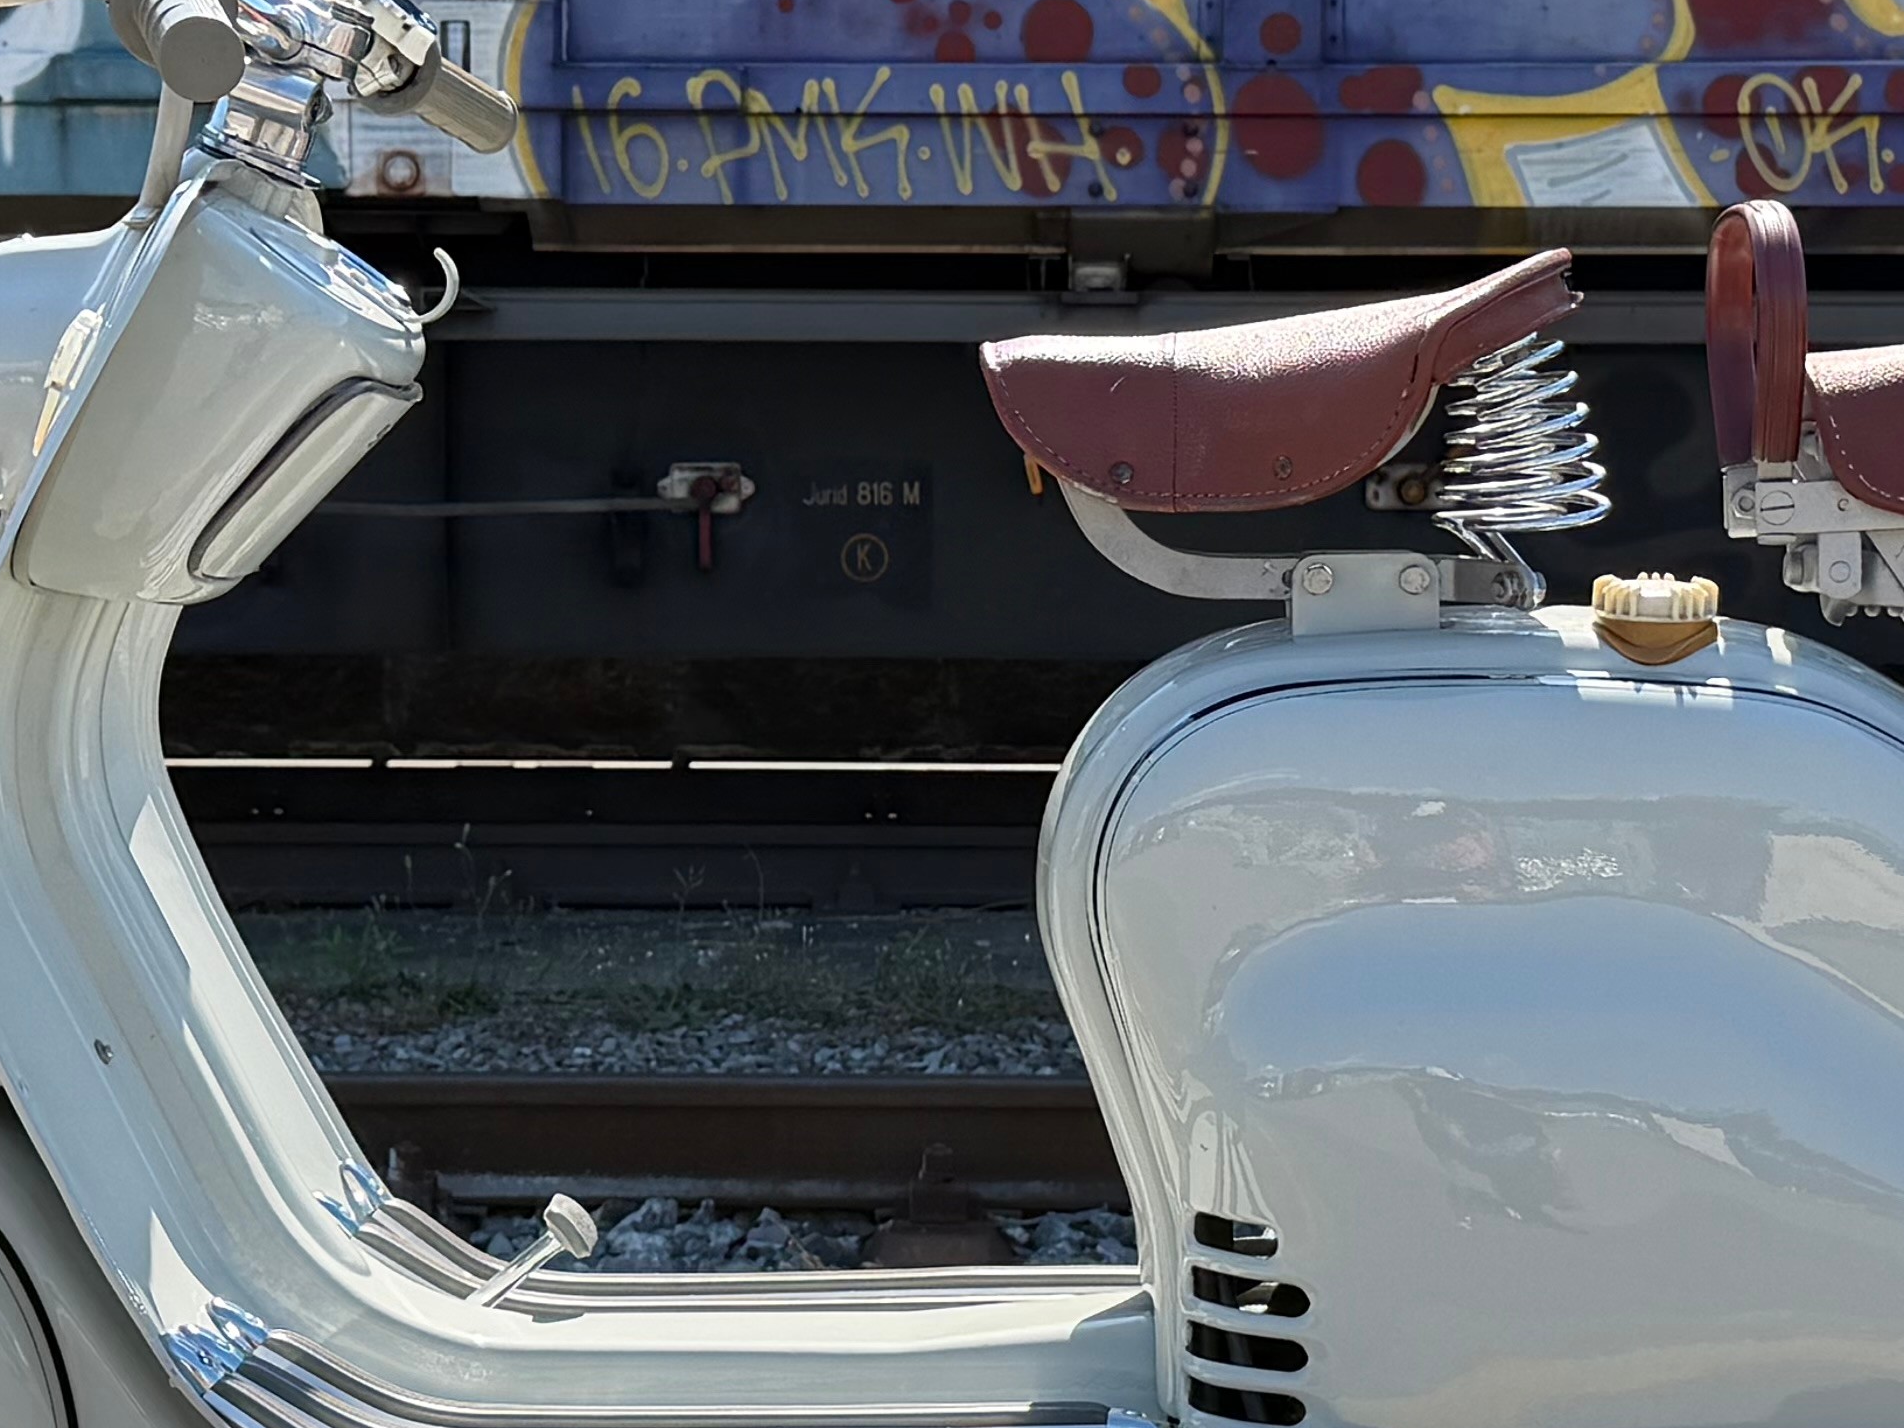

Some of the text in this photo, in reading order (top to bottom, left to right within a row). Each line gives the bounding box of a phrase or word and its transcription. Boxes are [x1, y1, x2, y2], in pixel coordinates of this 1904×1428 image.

[802, 481, 920, 506] Jurid 816 M
